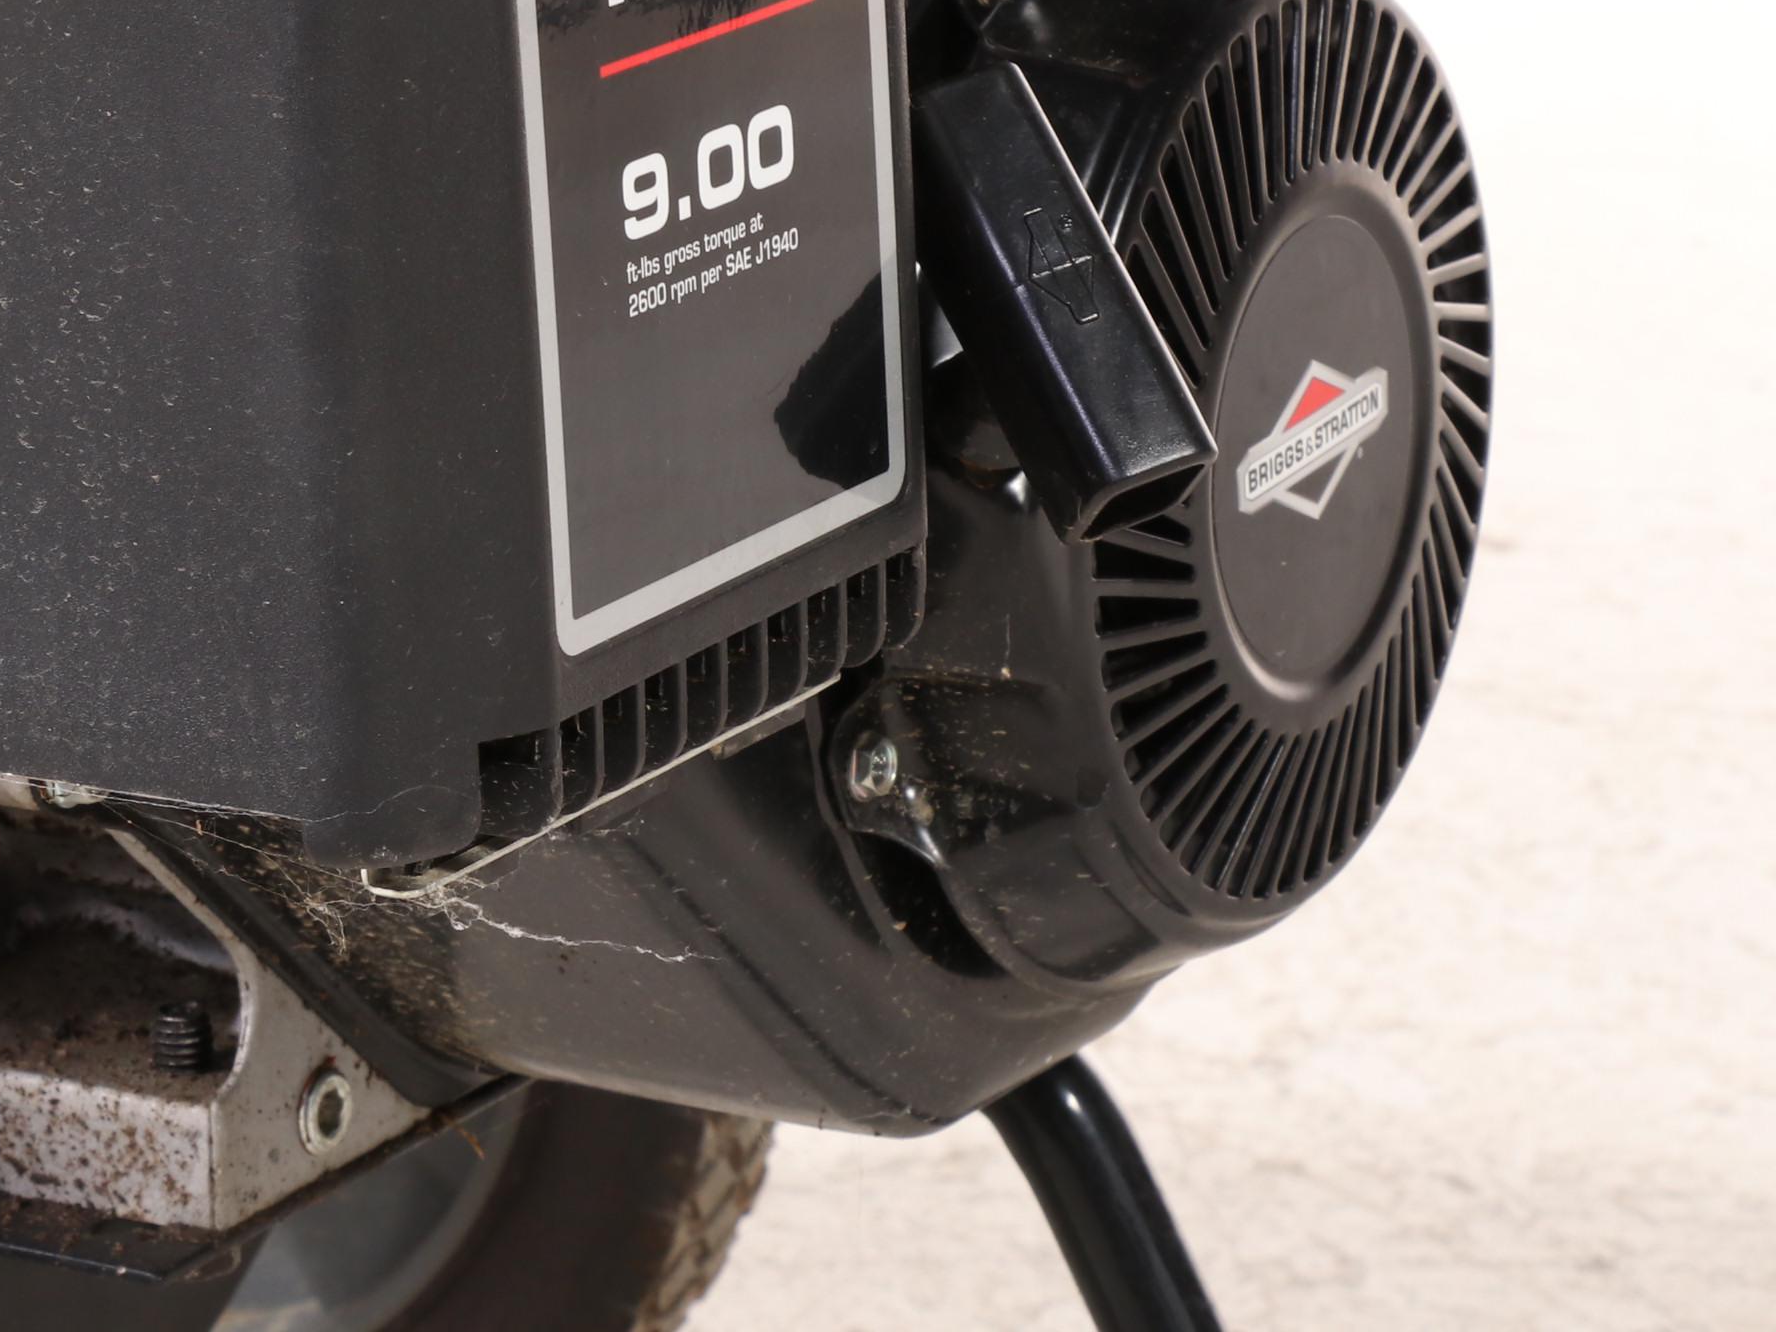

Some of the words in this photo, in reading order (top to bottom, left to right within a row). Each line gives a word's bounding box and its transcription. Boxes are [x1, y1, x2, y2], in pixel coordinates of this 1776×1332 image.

[621, 104, 795, 241] 9.00
[626, 255, 661, 285] ft-lbs
[664, 240, 701, 275] gross
[704, 221, 746, 250] torque
[749, 212, 765, 234] at
[628, 281, 667, 318] 2600
[670, 274, 698, 304] rpm
[700, 264, 723, 294] per
[725, 245, 753, 277] SAE
[755, 227, 799, 265] J1940
